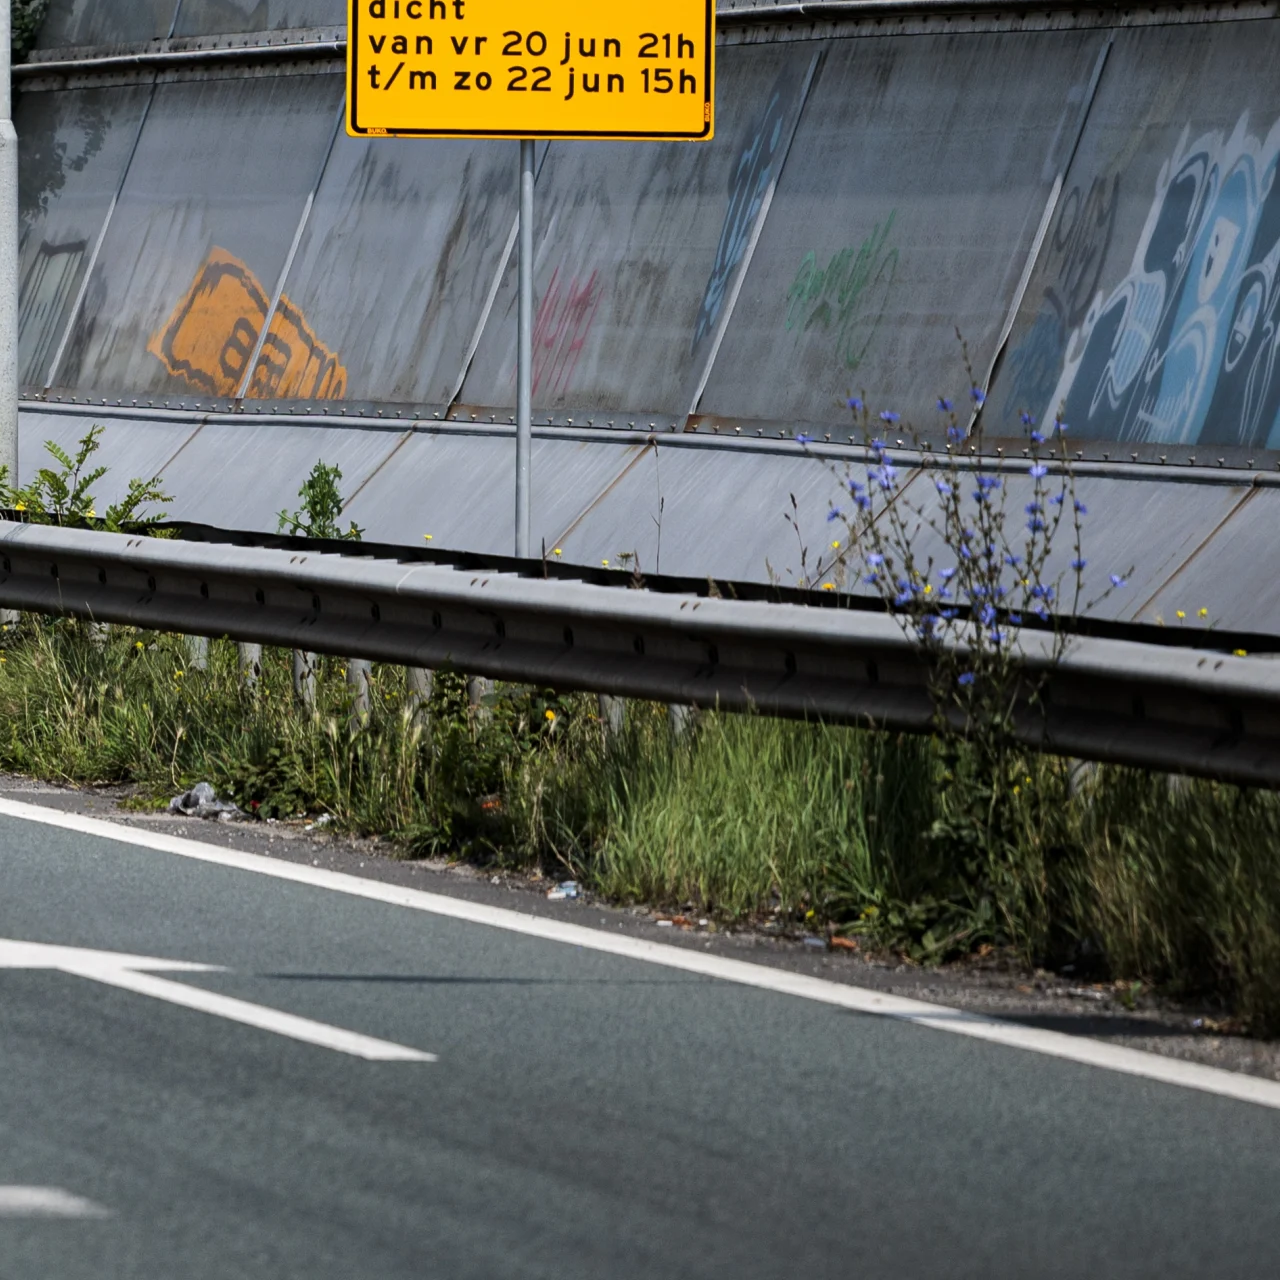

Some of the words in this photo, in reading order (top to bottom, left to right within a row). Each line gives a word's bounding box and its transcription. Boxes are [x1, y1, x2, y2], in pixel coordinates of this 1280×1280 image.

[369, 34, 433, 55] van
[451, 35, 488, 56] vr
[502, 31, 547, 56] 20
[560, 32, 621, 65] jun
[638, 33, 695, 58] 21h
[368, 62, 437, 90] t/m
[454, 70, 492, 91] zo
[507, 66, 551, 91] 22
[565, 67, 625, 100] jun
[641, 68, 696, 94] 15h
